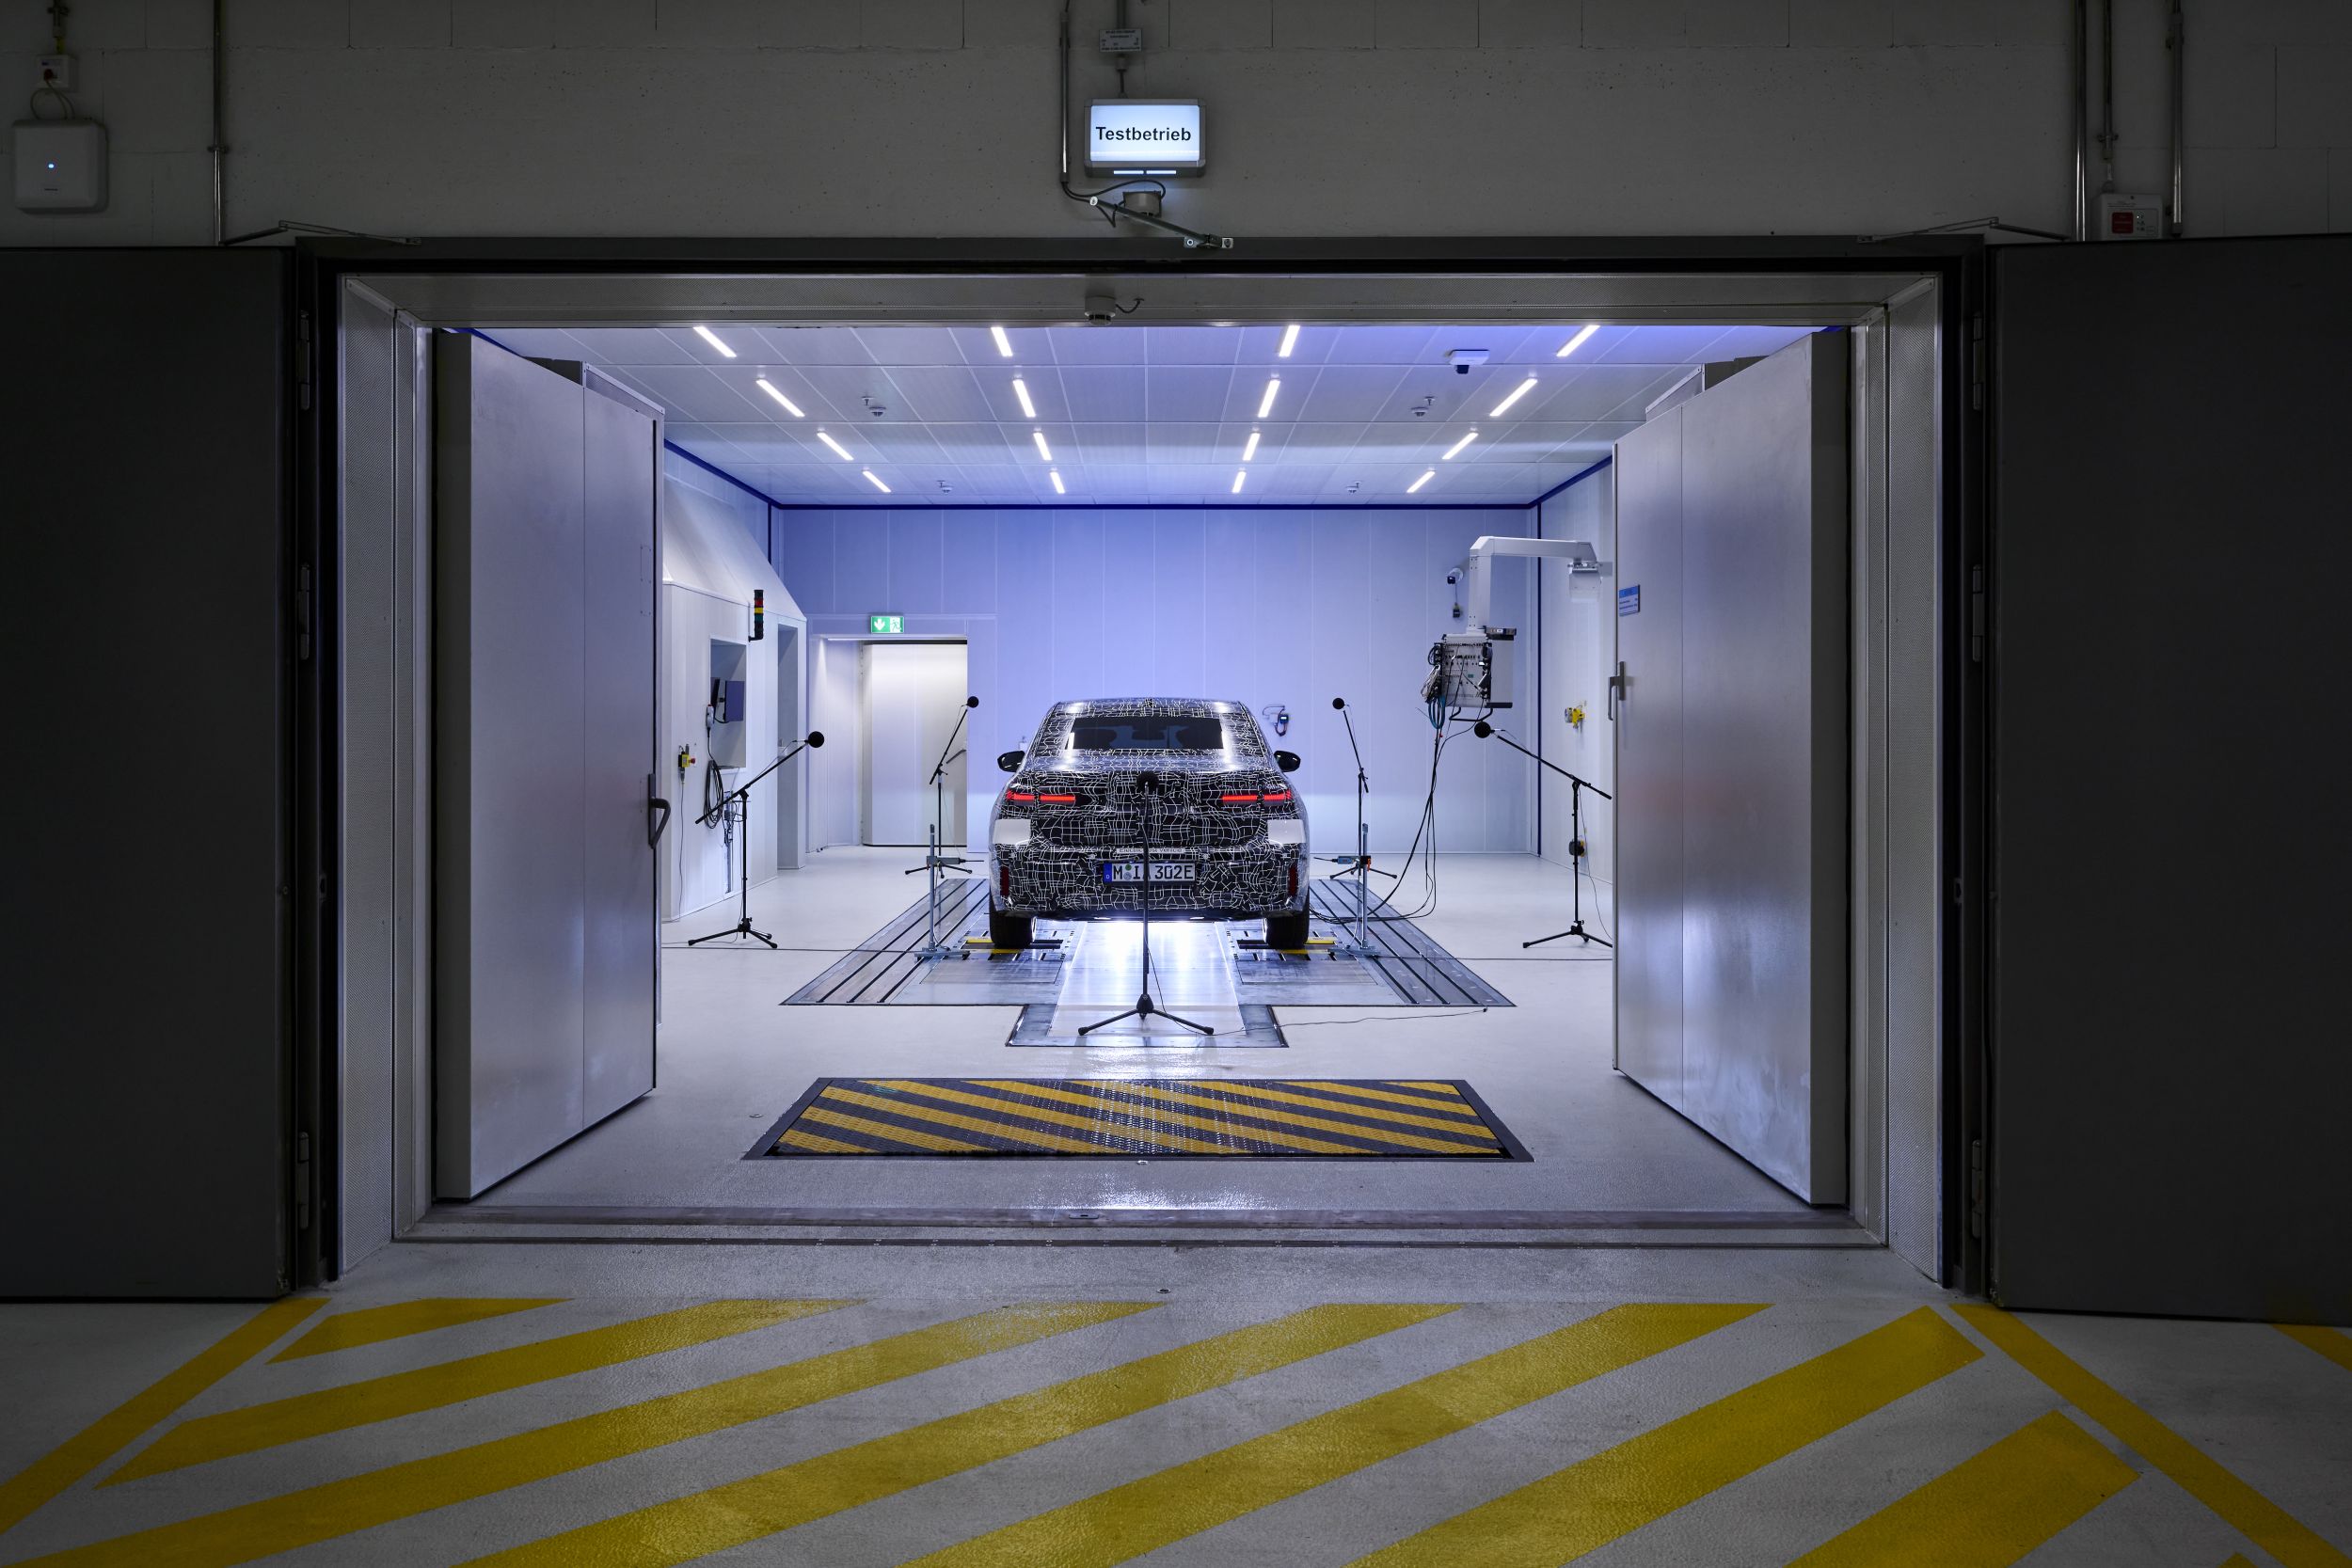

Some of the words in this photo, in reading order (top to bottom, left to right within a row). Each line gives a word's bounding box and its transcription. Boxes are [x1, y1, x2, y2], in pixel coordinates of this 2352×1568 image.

[1096, 126, 1191, 141] Testbetrieb
[1113, 865, 1123, 879] M
[1154, 865, 1194, 879] 302E
